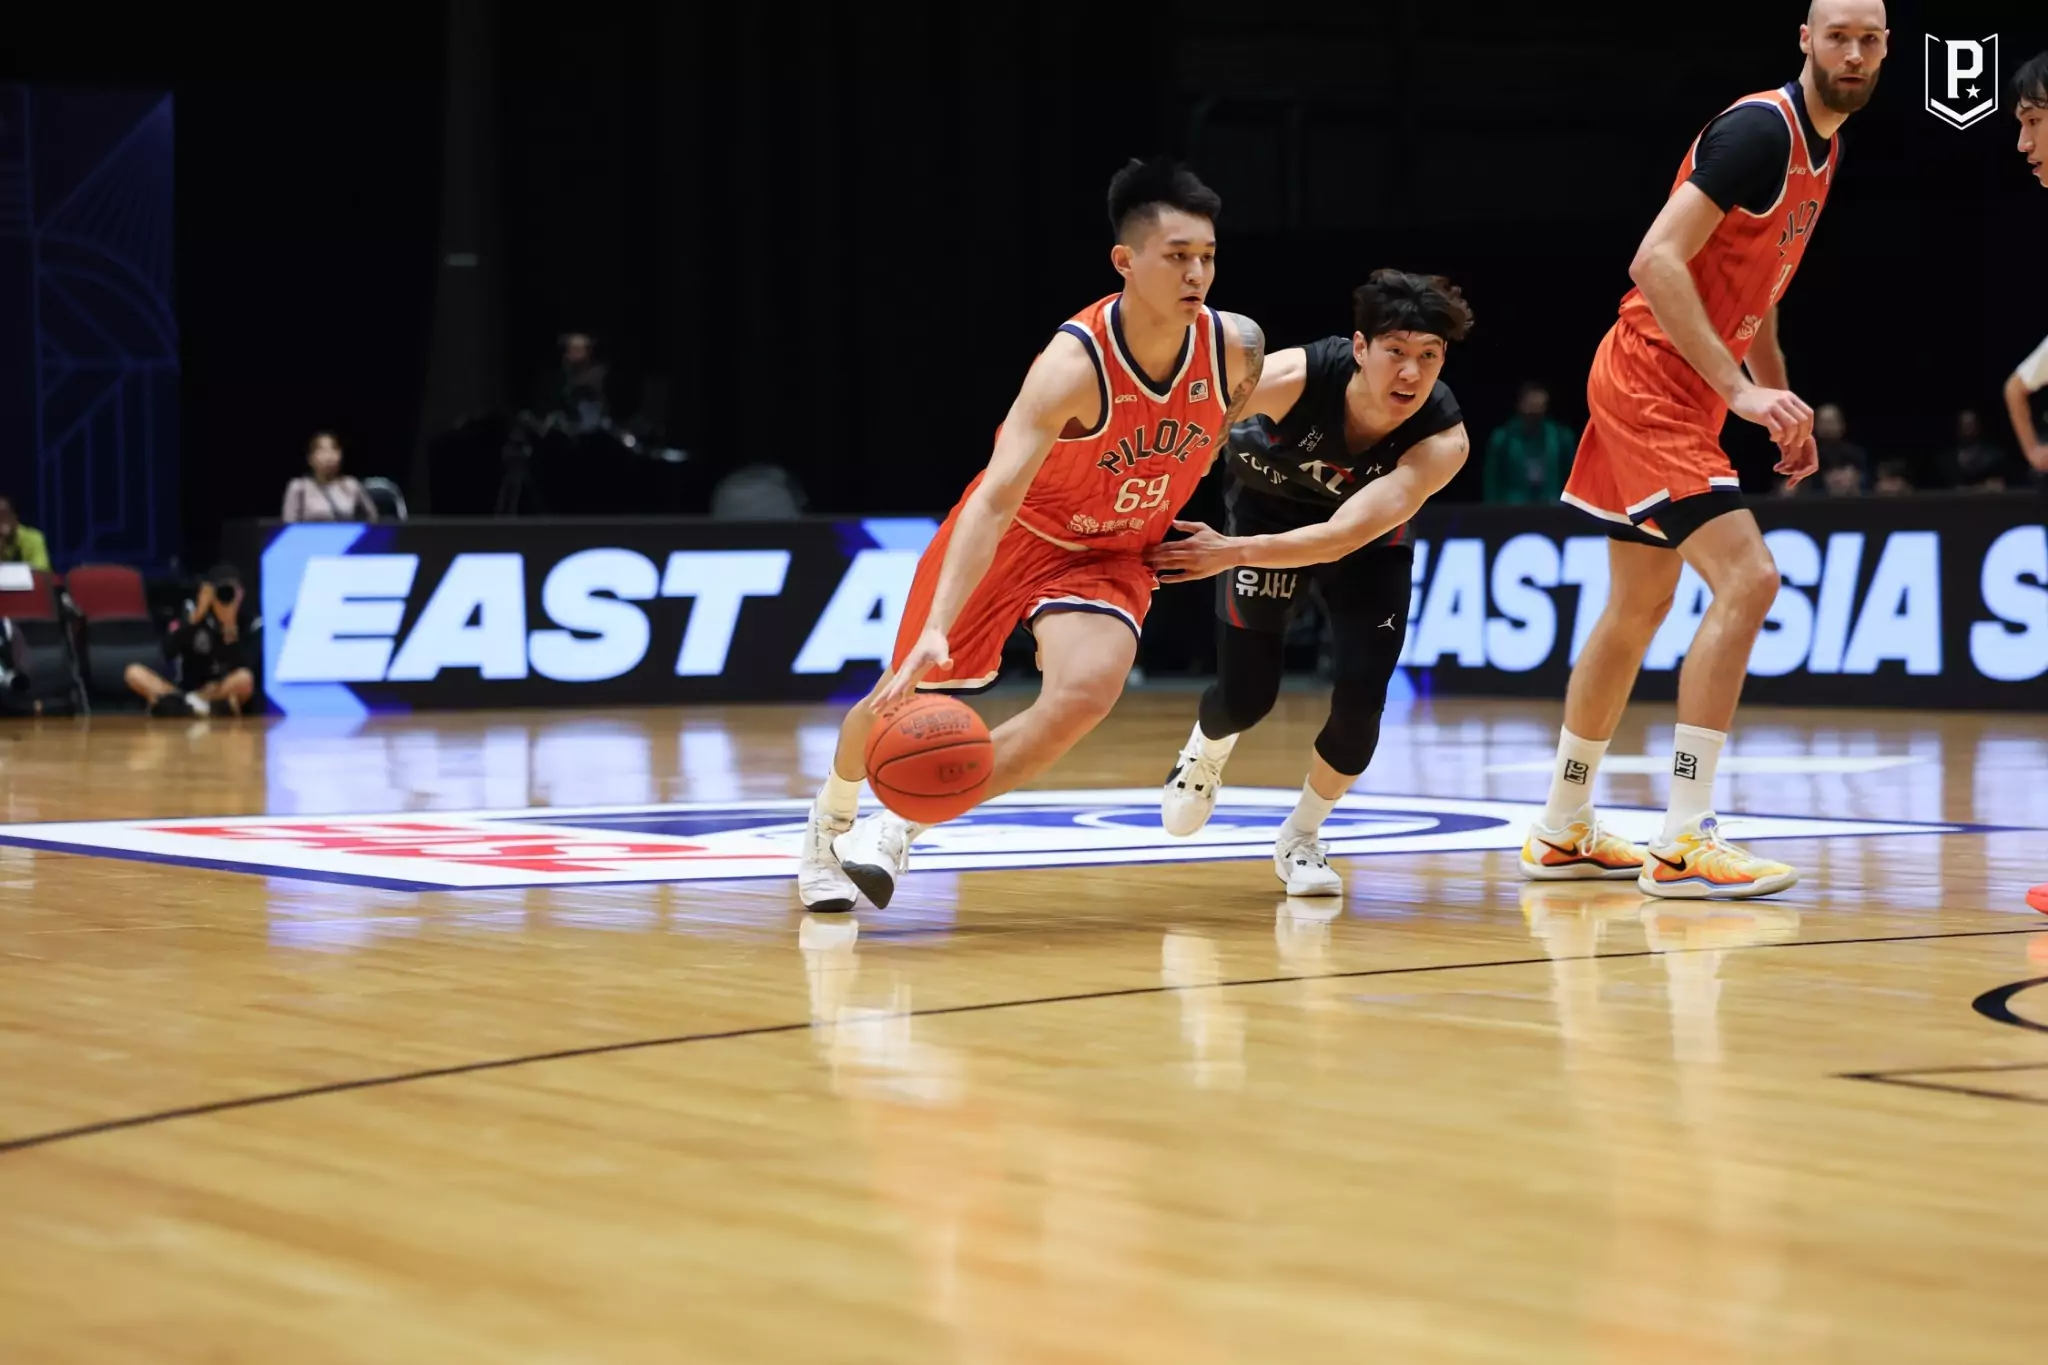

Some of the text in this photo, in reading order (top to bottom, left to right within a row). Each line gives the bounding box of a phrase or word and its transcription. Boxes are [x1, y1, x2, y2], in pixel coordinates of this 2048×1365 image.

[1114, 474, 1170, 512] 69
[1235, 569, 1298, 599] 유사나
[274, 548, 790, 682] EAST
